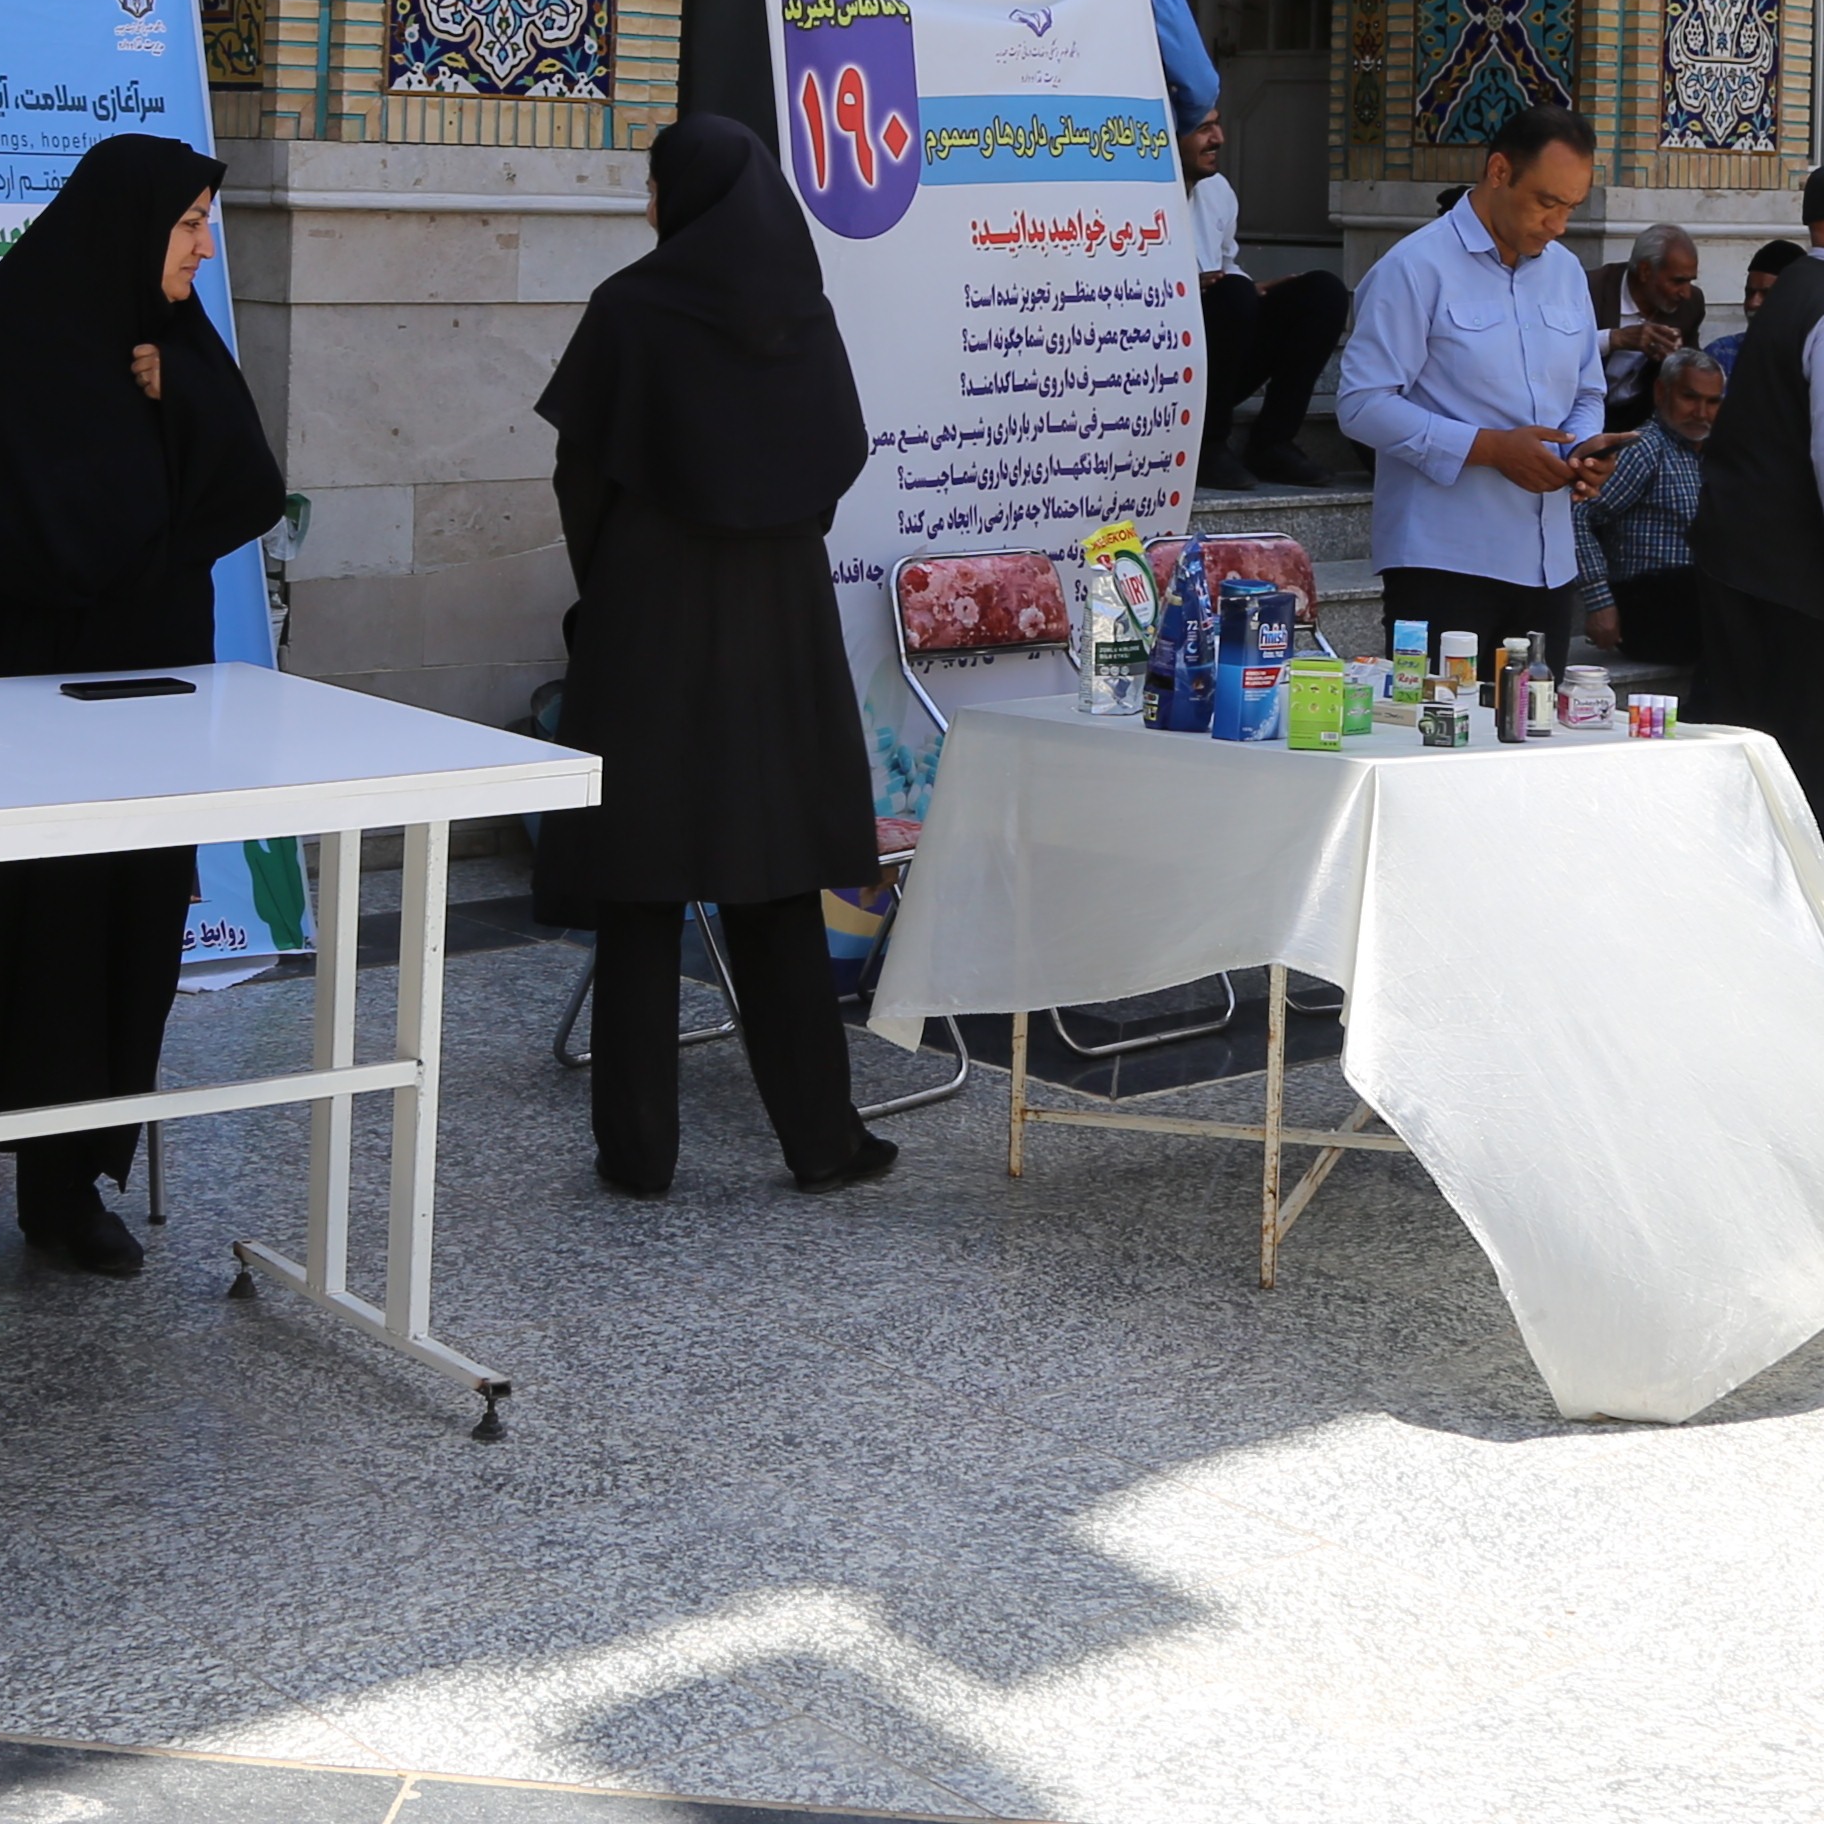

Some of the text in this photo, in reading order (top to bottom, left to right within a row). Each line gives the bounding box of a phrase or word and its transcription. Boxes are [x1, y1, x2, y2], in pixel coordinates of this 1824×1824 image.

[92, 80, 165, 123] سرآغازی
[801, 67, 908, 190] ۱۹۰
[924, 123, 979, 164] سموم
[995, 114, 1048, 158] داروها
[1050, 115, 1100, 157] رسانی
[1101, 117, 1139, 163] اطلاع
[1138, 121, 1169, 160] مرکز
[1050, 209, 1106, 257] خواهید
[1109, 219, 1133, 256] می
[1137, 209, 1168, 254] اگر
[997, 282, 1019, 306] شده
[1019, 281, 1051, 313] تجویز
[1052, 279, 1096, 311] منظور
[1098, 281, 1112, 309] چه
[1114, 286, 1124, 307] به
[1124, 278, 1142, 300] شما
[1144, 278, 1174, 307] داروی
[994, 326, 1023, 358] چگونه
[1025, 325, 1044, 348] شما
[1045, 323, 1082, 354] داروی
[1084, 322, 1118, 353] مصرف
[1119, 325, 1150, 352] صحیح
[1152, 321, 1178, 350] روش
[1012, 368, 1038, 393] شما
[1038, 366, 1076, 398] داروی
[1077, 365, 1122, 397] مصرف
[1123, 368, 1142, 395] منع
[1143, 363, 1179, 394] موارد
[992, 412, 1031, 446] بارداری
[1032, 414, 1045, 435] در
[1046, 410, 1077, 434] شما
[1079, 411, 1130, 439] مصرفی
[1131, 404, 1163, 437] داروی
[1163, 402, 1178, 426] آیا
[897, 425, 929, 454] منع
[950, 462, 977, 486] شما
[977, 460, 1008, 491] داروی
[1008, 455, 1032, 485] برای
[1031, 454, 1093, 484] نگهداری
[1093, 452, 1133, 480] شرایط
[1131, 451, 1173, 477] بهترین
[947, 505, 974, 531] ایجاد
[983, 501, 1025, 533] عوارضی
[1026, 504, 1040, 529] چه
[1085, 496, 1102, 519] شما
[1101, 494, 1135, 522] مصرفی
[1136, 488, 1166, 518] داروی
[927, 518, 944, 540] می
[1187, 621, 1198, 630] 72
[200, 920, 246, 951] روابط
